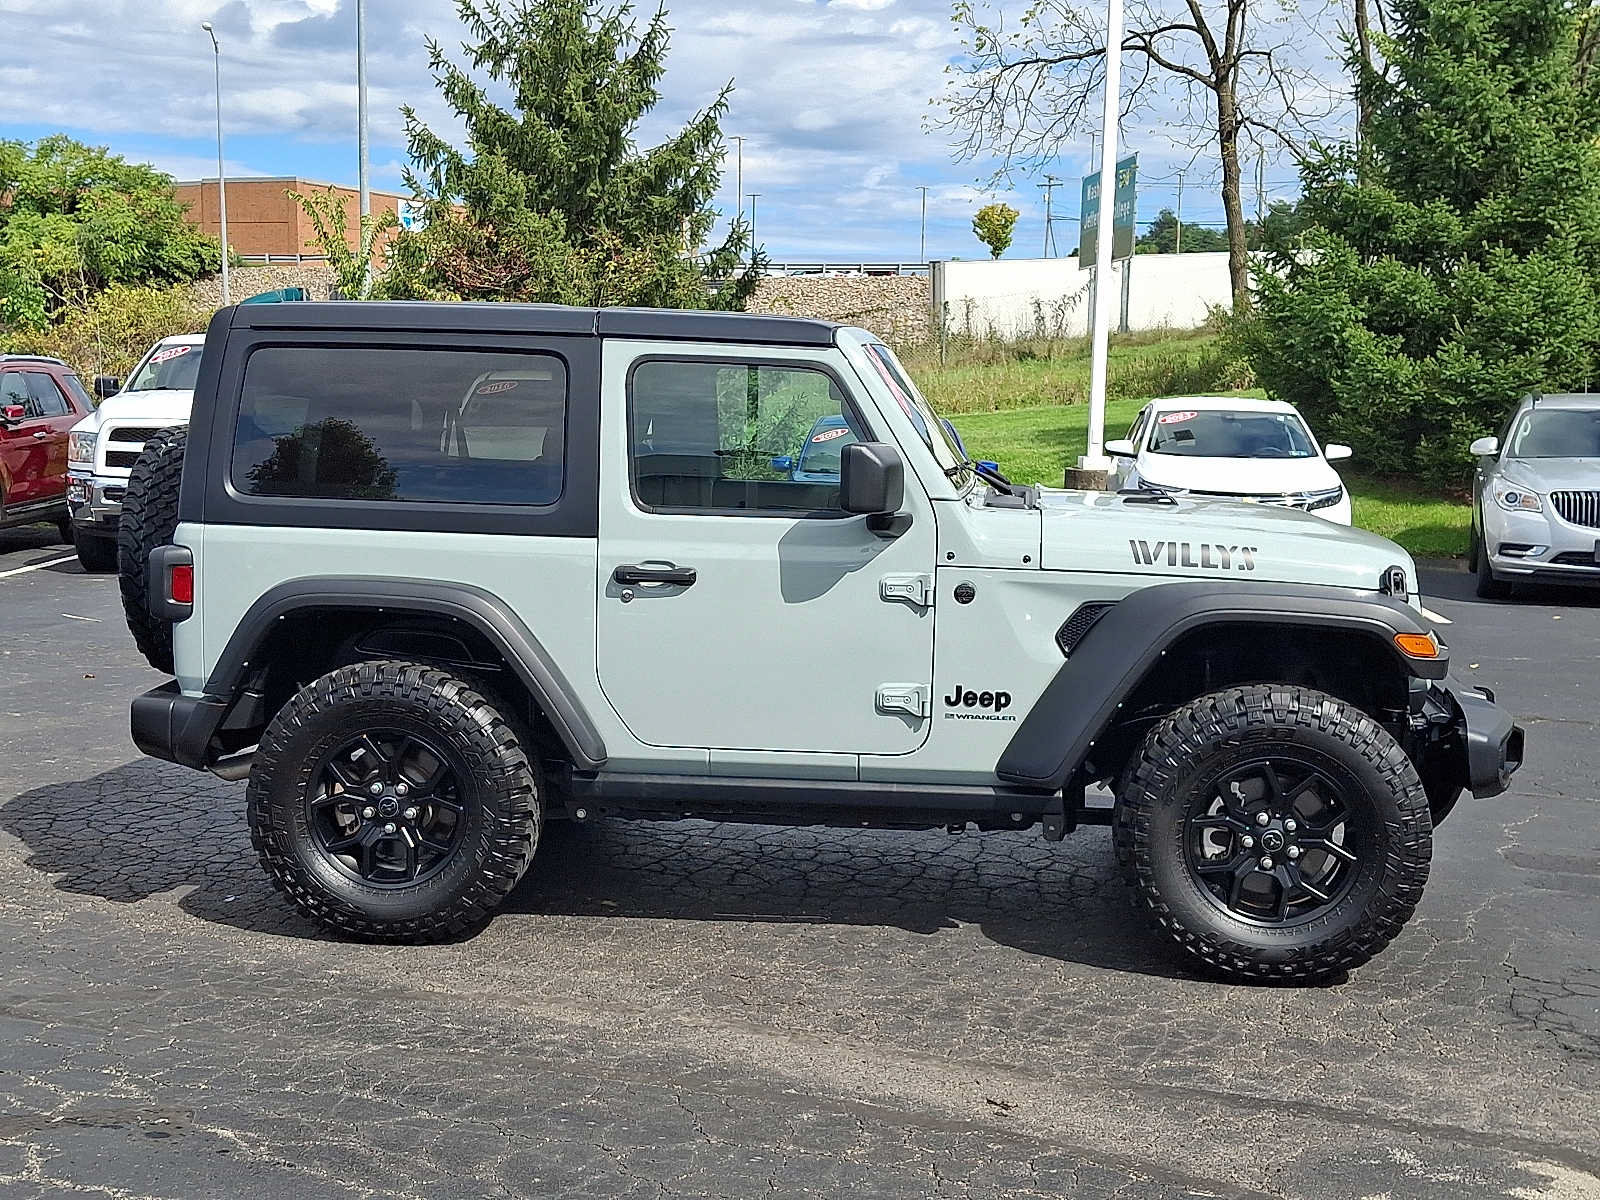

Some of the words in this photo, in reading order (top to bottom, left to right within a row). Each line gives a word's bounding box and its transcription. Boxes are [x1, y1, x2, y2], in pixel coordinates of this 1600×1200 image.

[1129, 539, 1258, 571] WILLYS
[944, 684, 1012, 712] Jeep
[956, 713, 1017, 721] WRANGLER
